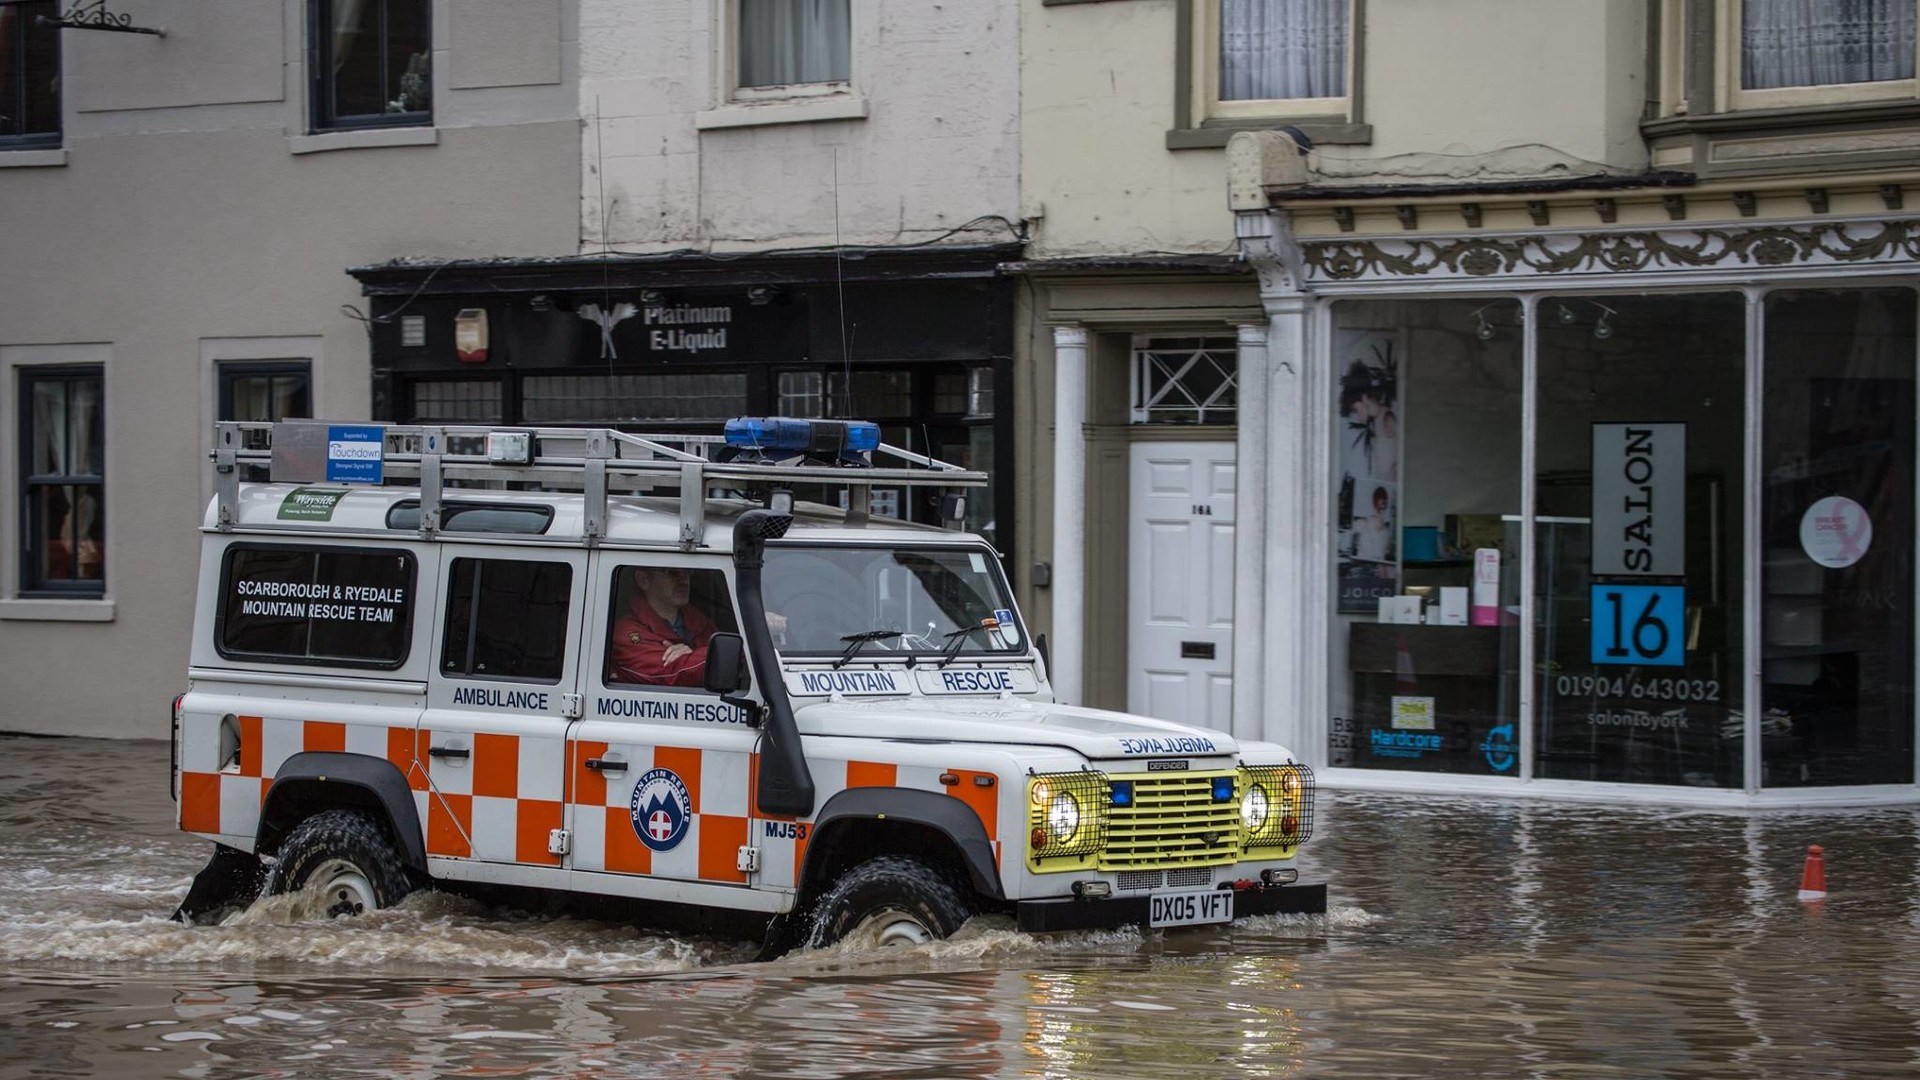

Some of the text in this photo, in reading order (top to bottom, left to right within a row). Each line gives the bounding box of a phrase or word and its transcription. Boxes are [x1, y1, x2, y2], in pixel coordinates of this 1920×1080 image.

[643, 304, 731, 325] Platinum
[650, 328, 726, 353] E-Liquid
[330, 443, 380, 458] Touchdown
[296, 494, 336, 507] Wayside
[1624, 427, 1653, 573] SALON
[237, 580, 403, 604] SCARBOROUGH & RYEDALE
[242, 600, 394, 623] MOUNTAIN RESCUE TEAM
[1605, 592, 1669, 659] 16
[801, 671, 1013, 692] MOUNTAIN RESCUE
[1557, 675, 1720, 701] 01904 643032
[453, 687, 548, 710] AMBULANCE
[597, 698, 748, 725] MOUNTAIN RESCUE
[1370, 728, 1441, 748] Hardcore
[1149, 761, 1187, 770] DEFENDER
[632, 770, 690, 823] MOUNTAIN RESCUE
[765, 821, 807, 840] MJ53
[1152, 892, 1232, 922] DX05 VFT
